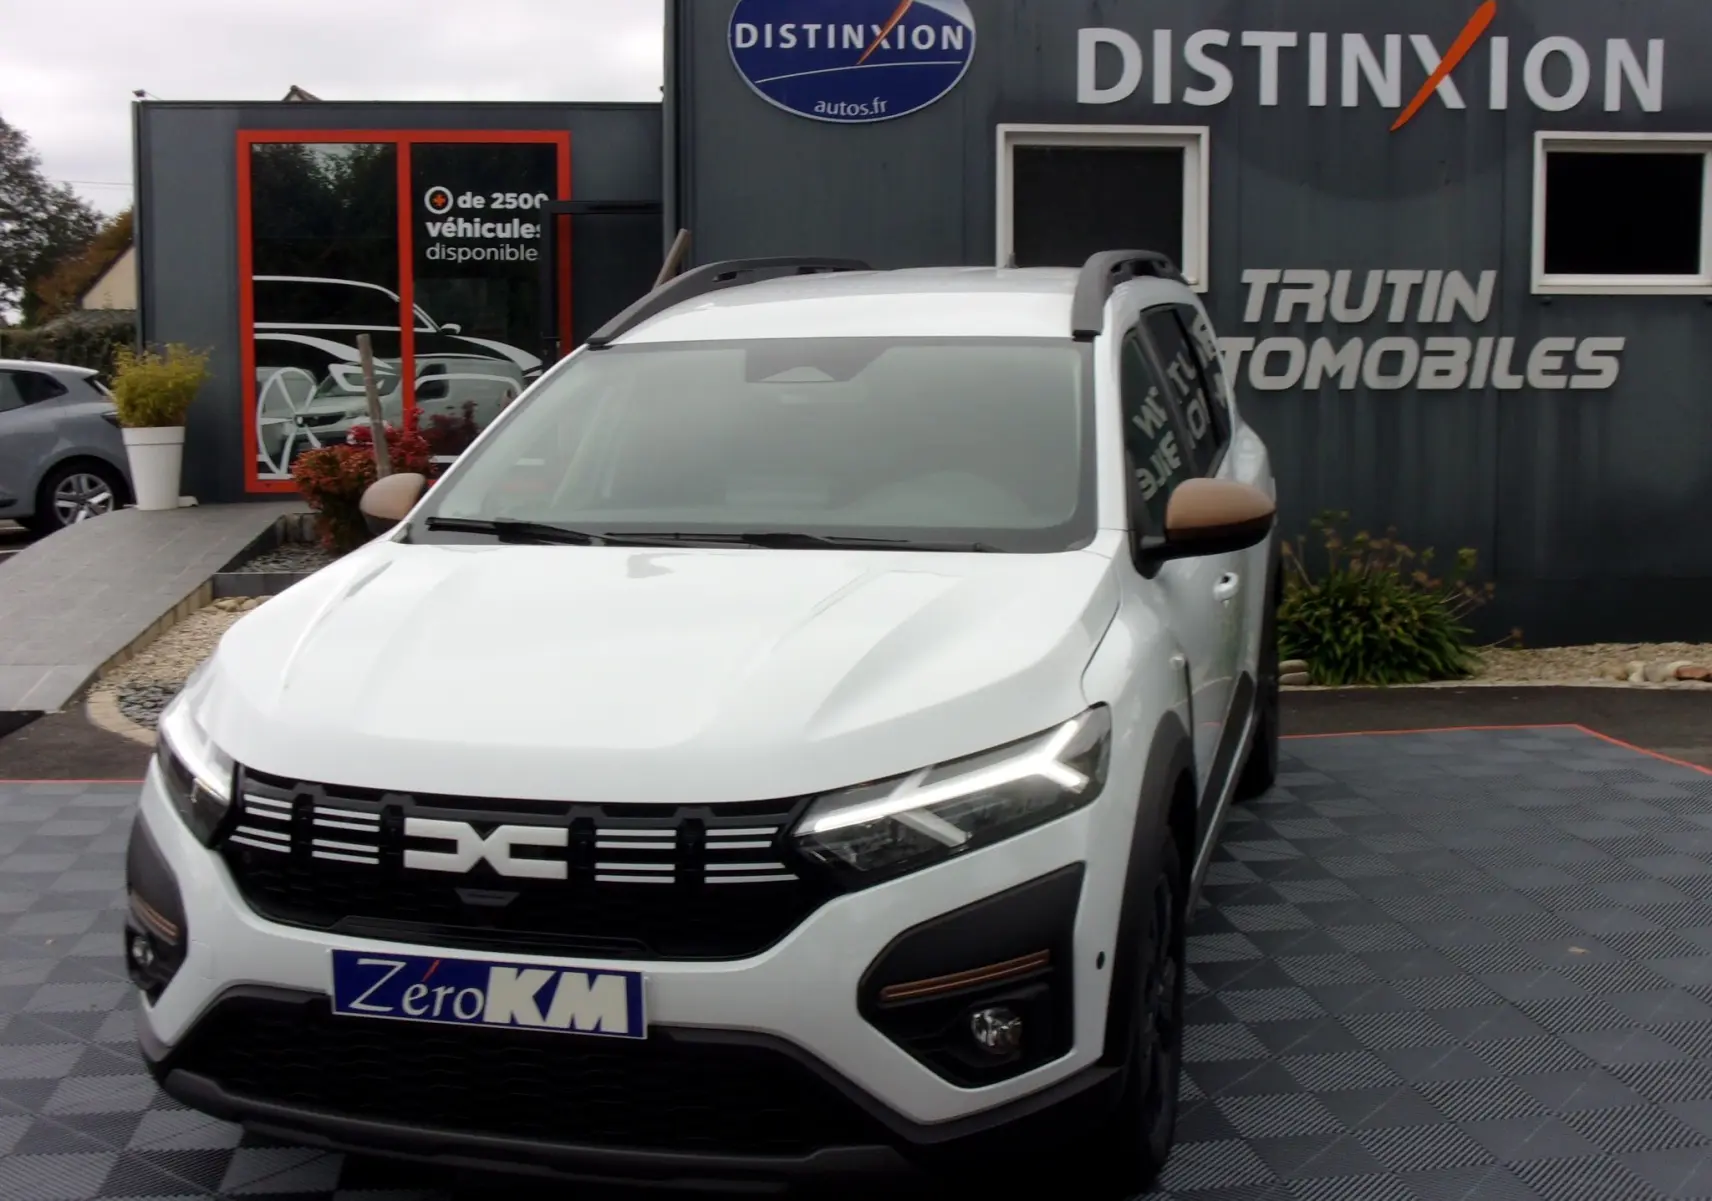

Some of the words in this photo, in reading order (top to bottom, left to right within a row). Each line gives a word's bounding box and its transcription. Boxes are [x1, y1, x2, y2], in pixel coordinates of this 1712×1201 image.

[1076, 0, 1664, 131] DISTINXION
[814, 97, 888, 116] autos.fr
[457, 192, 486, 208] de
[426, 242, 540, 263] disponible
[1241, 269, 1497, 323] TRUTIN
